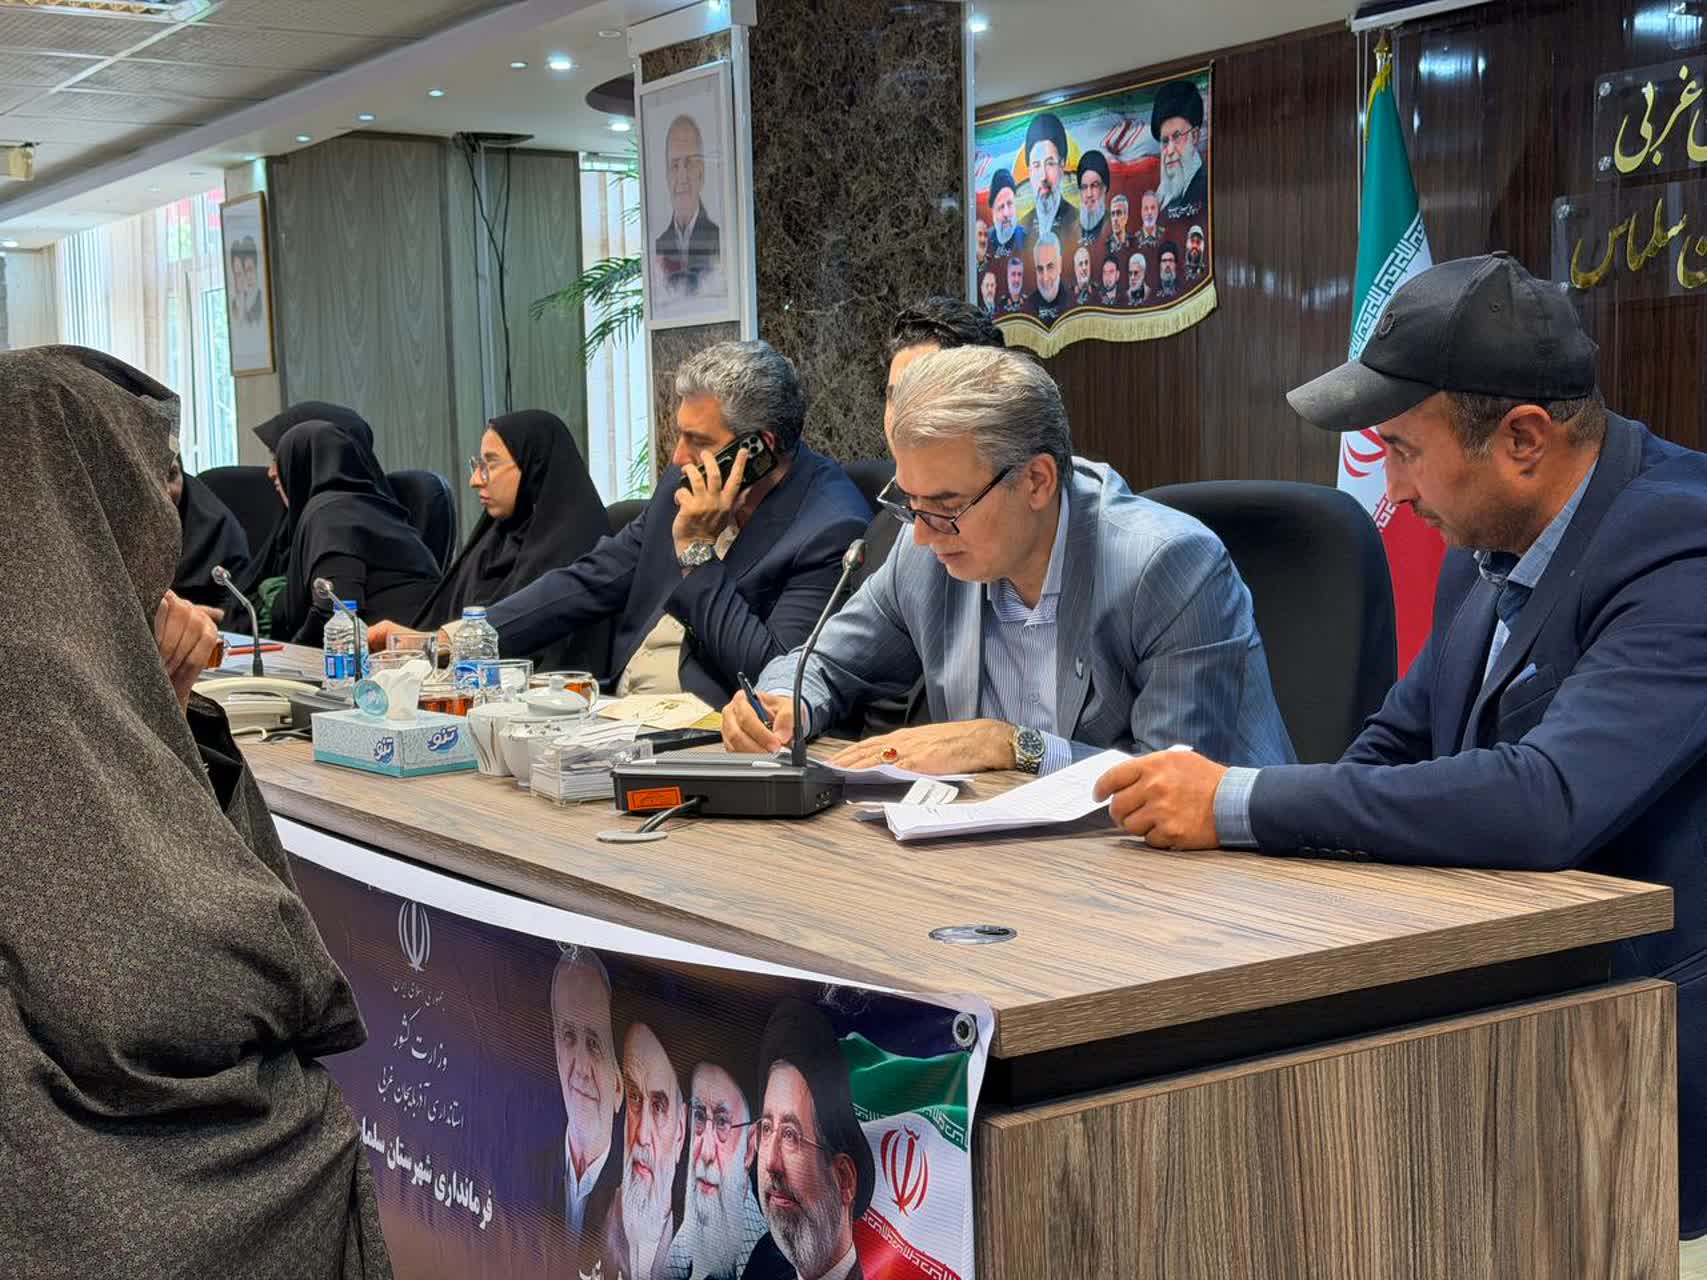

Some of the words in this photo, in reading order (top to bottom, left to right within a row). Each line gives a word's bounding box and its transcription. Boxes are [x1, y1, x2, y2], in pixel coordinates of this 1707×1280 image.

[1614, 64, 1704, 174] غربی
[1570, 198, 1687, 289] سلماس
[426, 725, 459, 752] تنو
[393, 1006, 424, 1049] کشور
[411, 1035, 448, 1072] وزارت
[359, 1115, 385, 1154] سلما
[386, 1135, 433, 1187] شهرستان
[434, 1170, 493, 1230] فرمانداری
